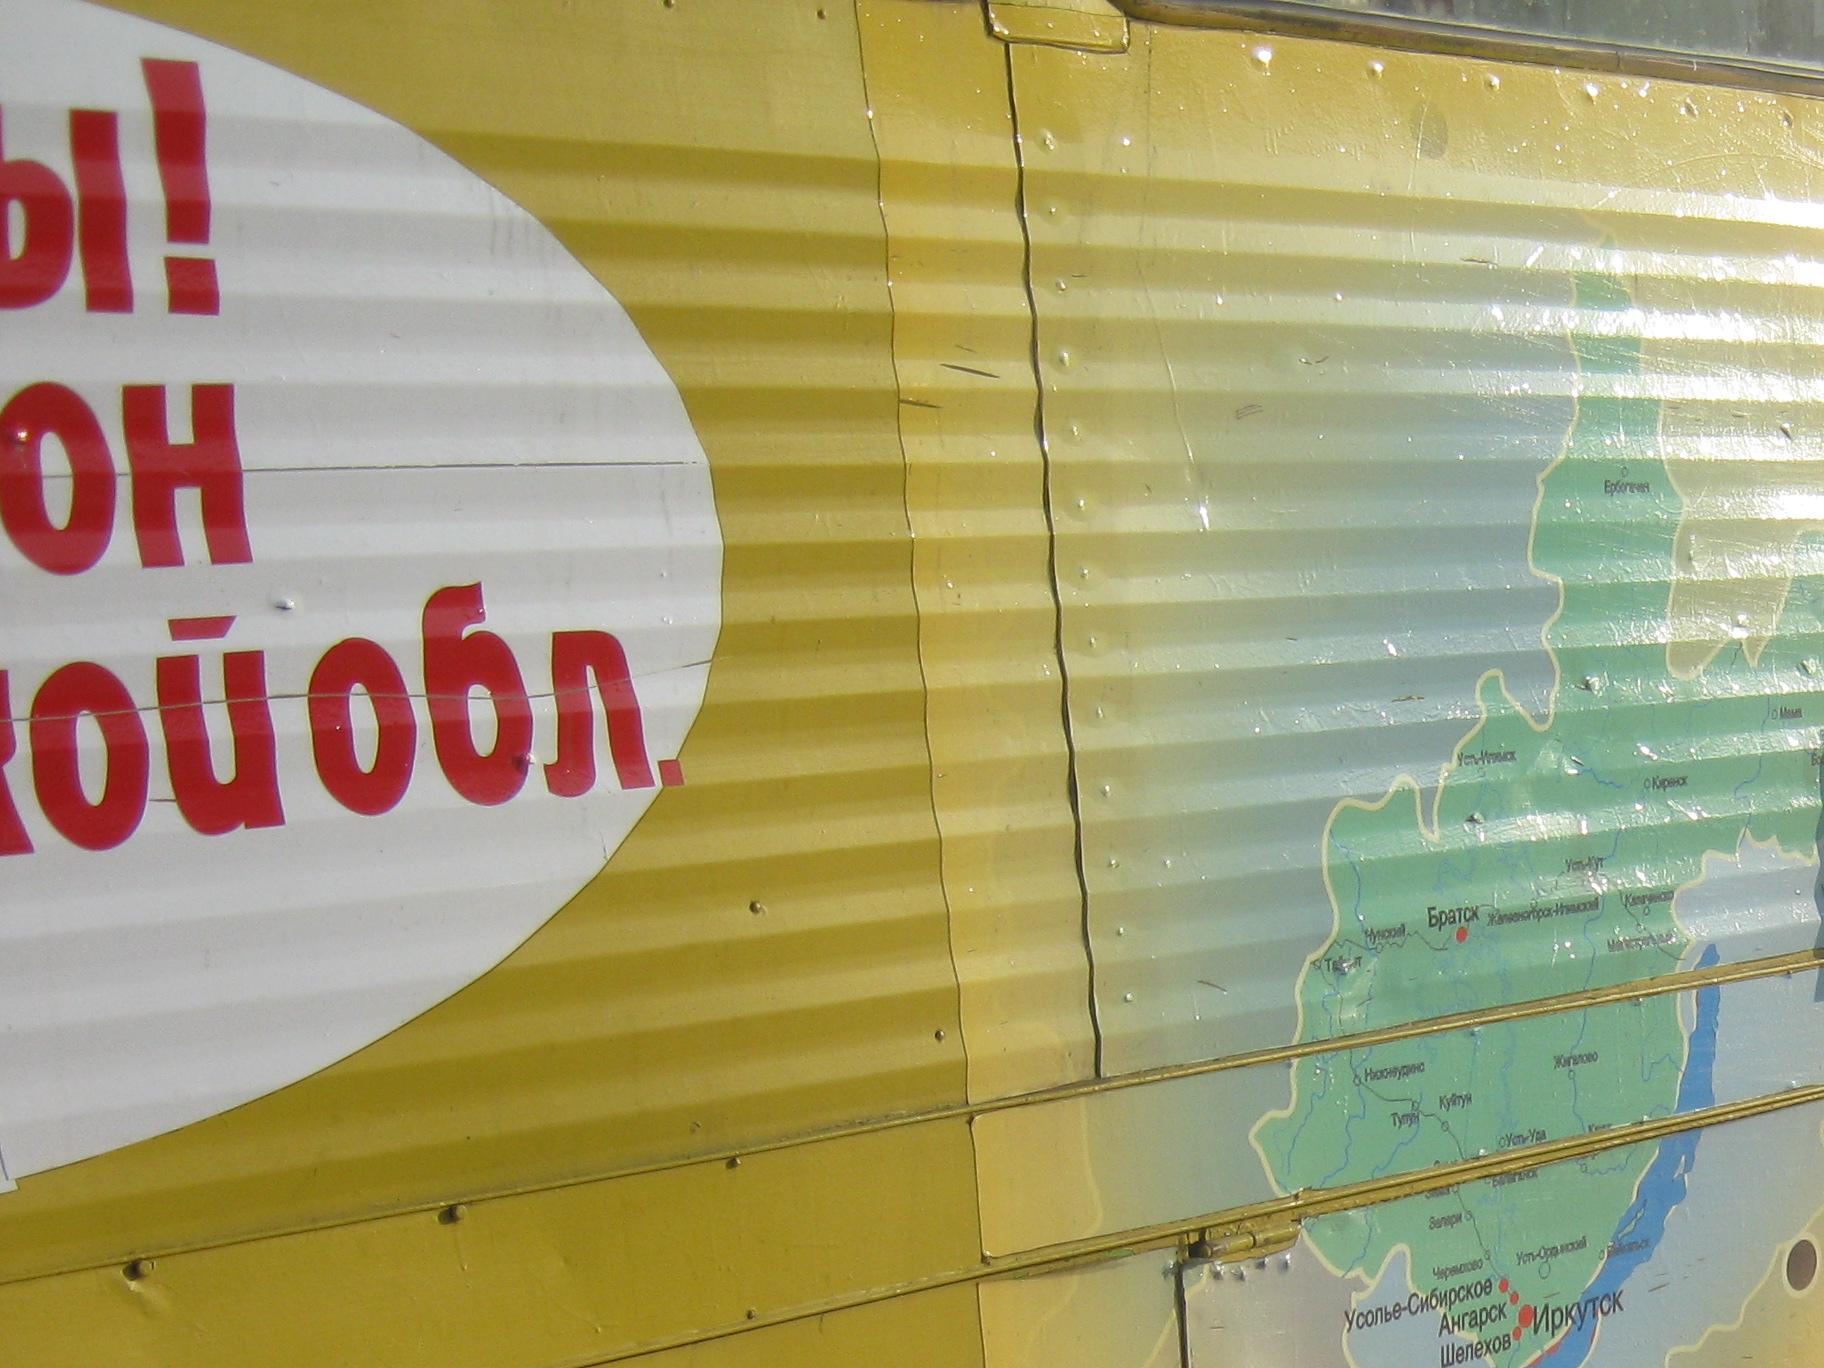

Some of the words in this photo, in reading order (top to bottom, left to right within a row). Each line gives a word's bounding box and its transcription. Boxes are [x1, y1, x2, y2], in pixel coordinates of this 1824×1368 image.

[308, 582, 685, 818] обл.
[1427, 905, 1480, 932] Братск
[1344, 1277, 1493, 1334] Усолье-Сибирское
[1438, 1301, 1507, 1338] Ангарск
[1533, 1290, 1625, 1338] Иркутск
[1440, 1332, 1512, 1368] Шелехов
